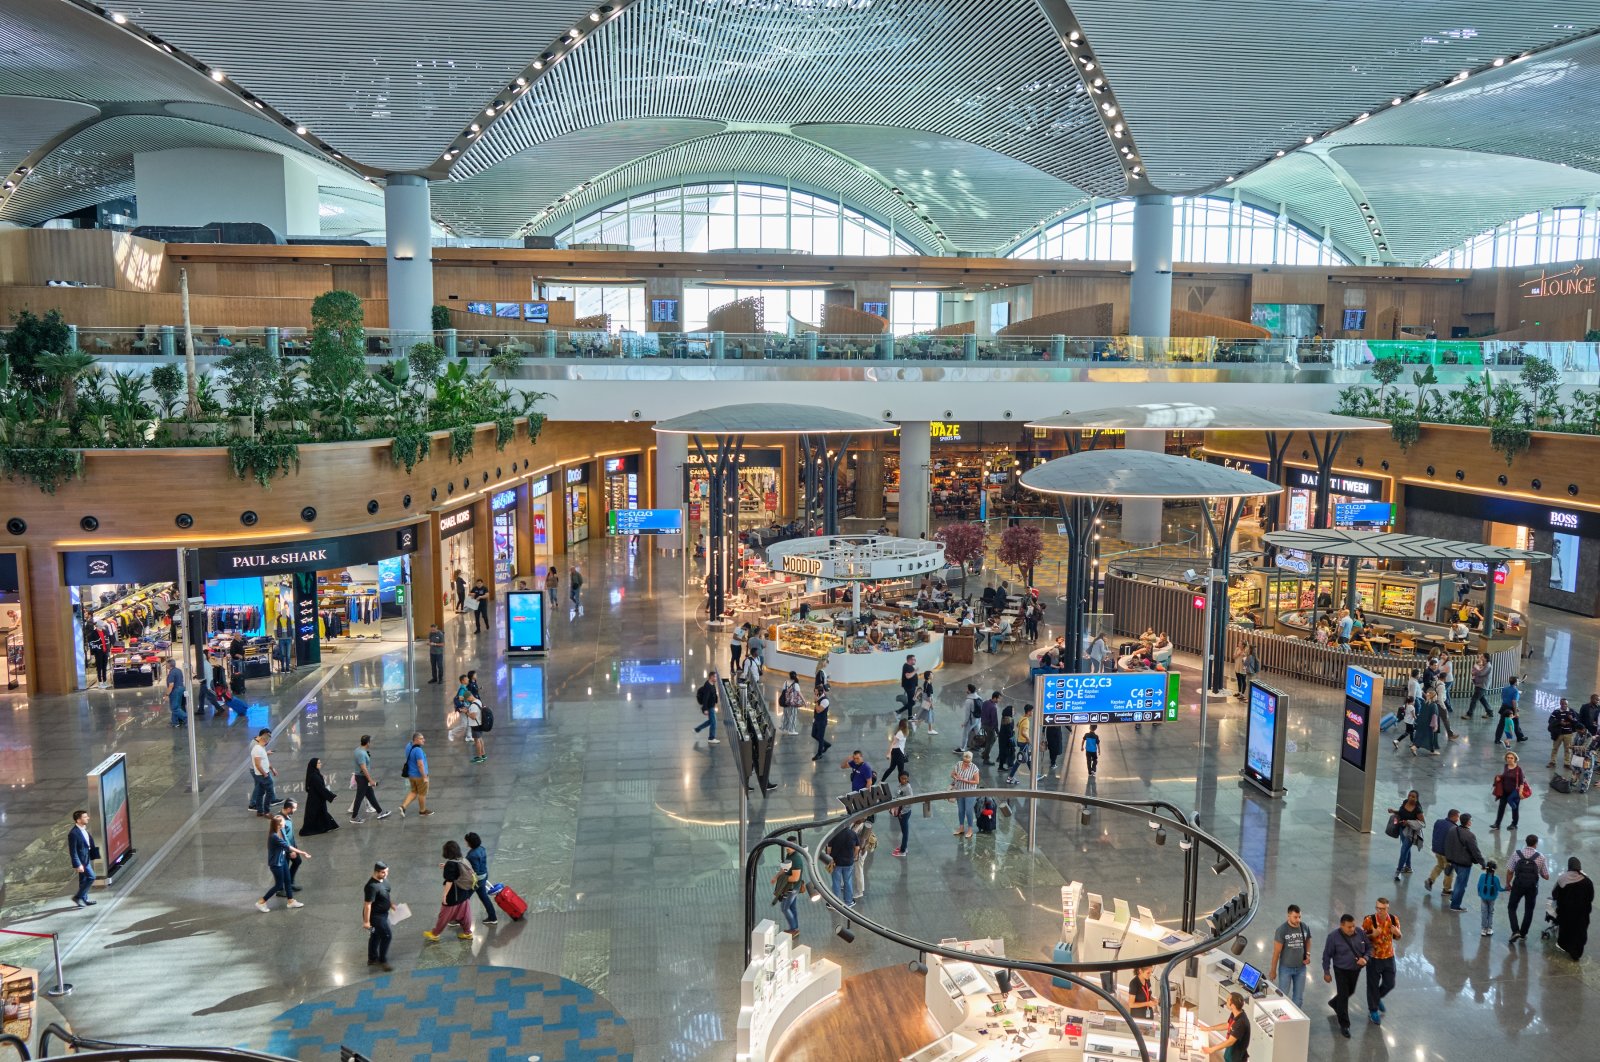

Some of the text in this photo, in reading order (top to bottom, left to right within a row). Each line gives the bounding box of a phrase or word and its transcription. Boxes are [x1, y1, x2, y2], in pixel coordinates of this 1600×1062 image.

[1543, 277, 1596, 297] LOUNGE
[1342, 479, 1369, 494] TWEEN
[457, 510, 470, 524] KORS
[1550, 511, 1578, 525] BOSS
[232, 549, 327, 568] PAUL & SHARK
[783, 556, 821, 575] MOOD UP
[1066, 677, 1112, 689] C1,C2,C3
[1065, 690, 1084, 699] D-E
[1130, 688, 1144, 698] C4
[1065, 701, 1071, 710] F
[1125, 700, 1144, 709] A-B
